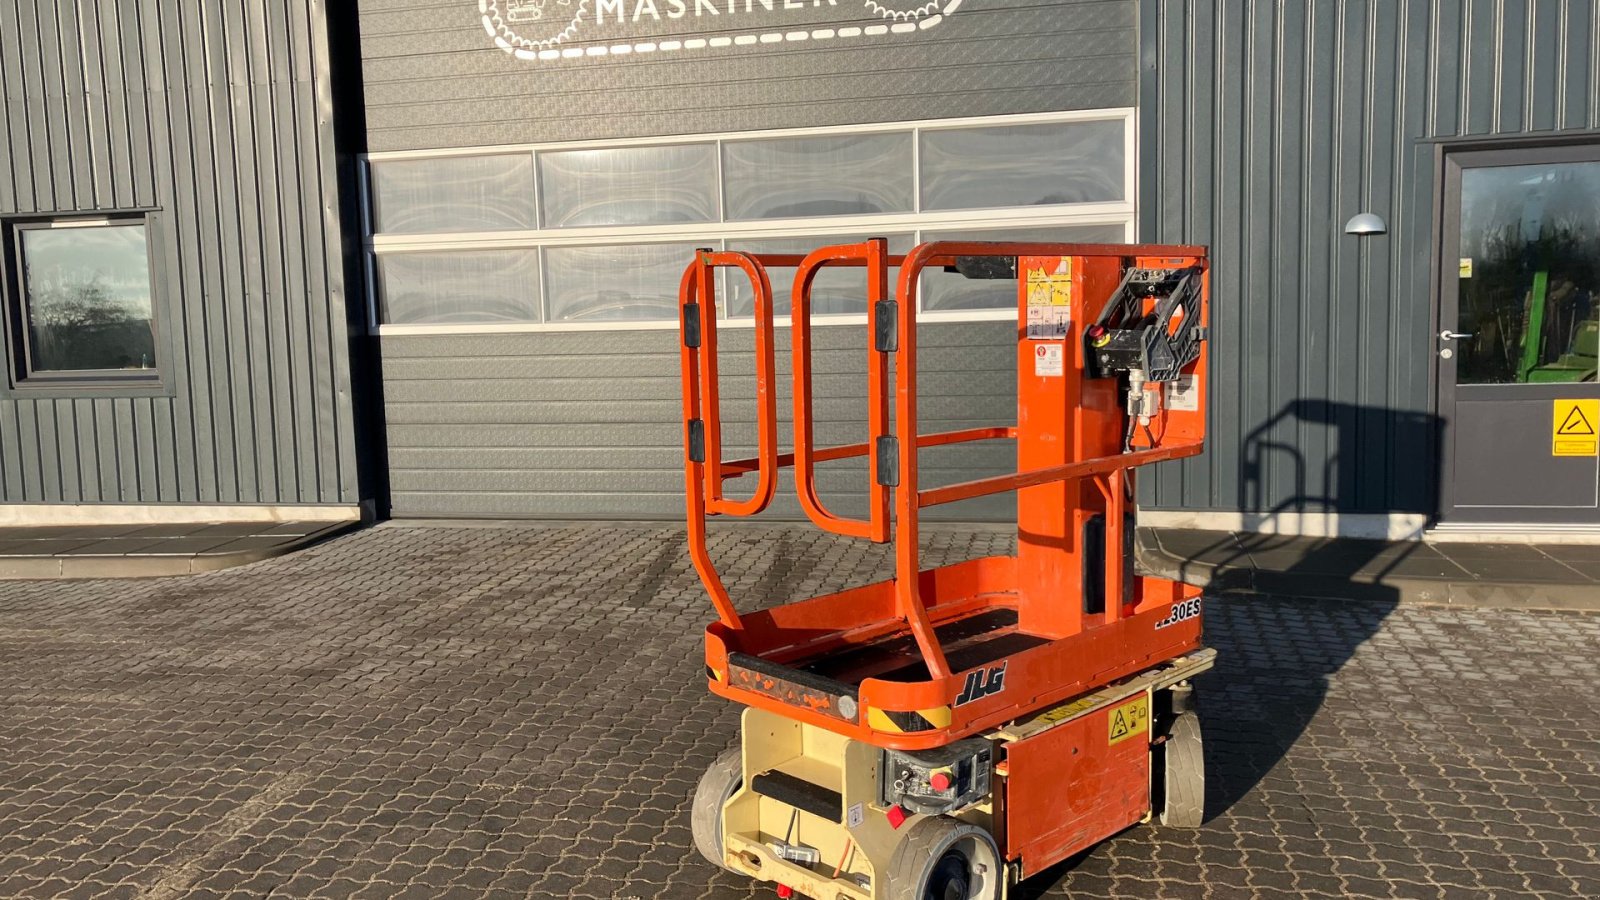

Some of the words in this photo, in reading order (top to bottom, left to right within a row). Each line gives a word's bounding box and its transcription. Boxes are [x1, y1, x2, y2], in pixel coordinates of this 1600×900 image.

[595, 0, 838, 25] MASK
[1155, 597, 1201, 629] 30ES
[954, 660, 1007, 707] JLG
